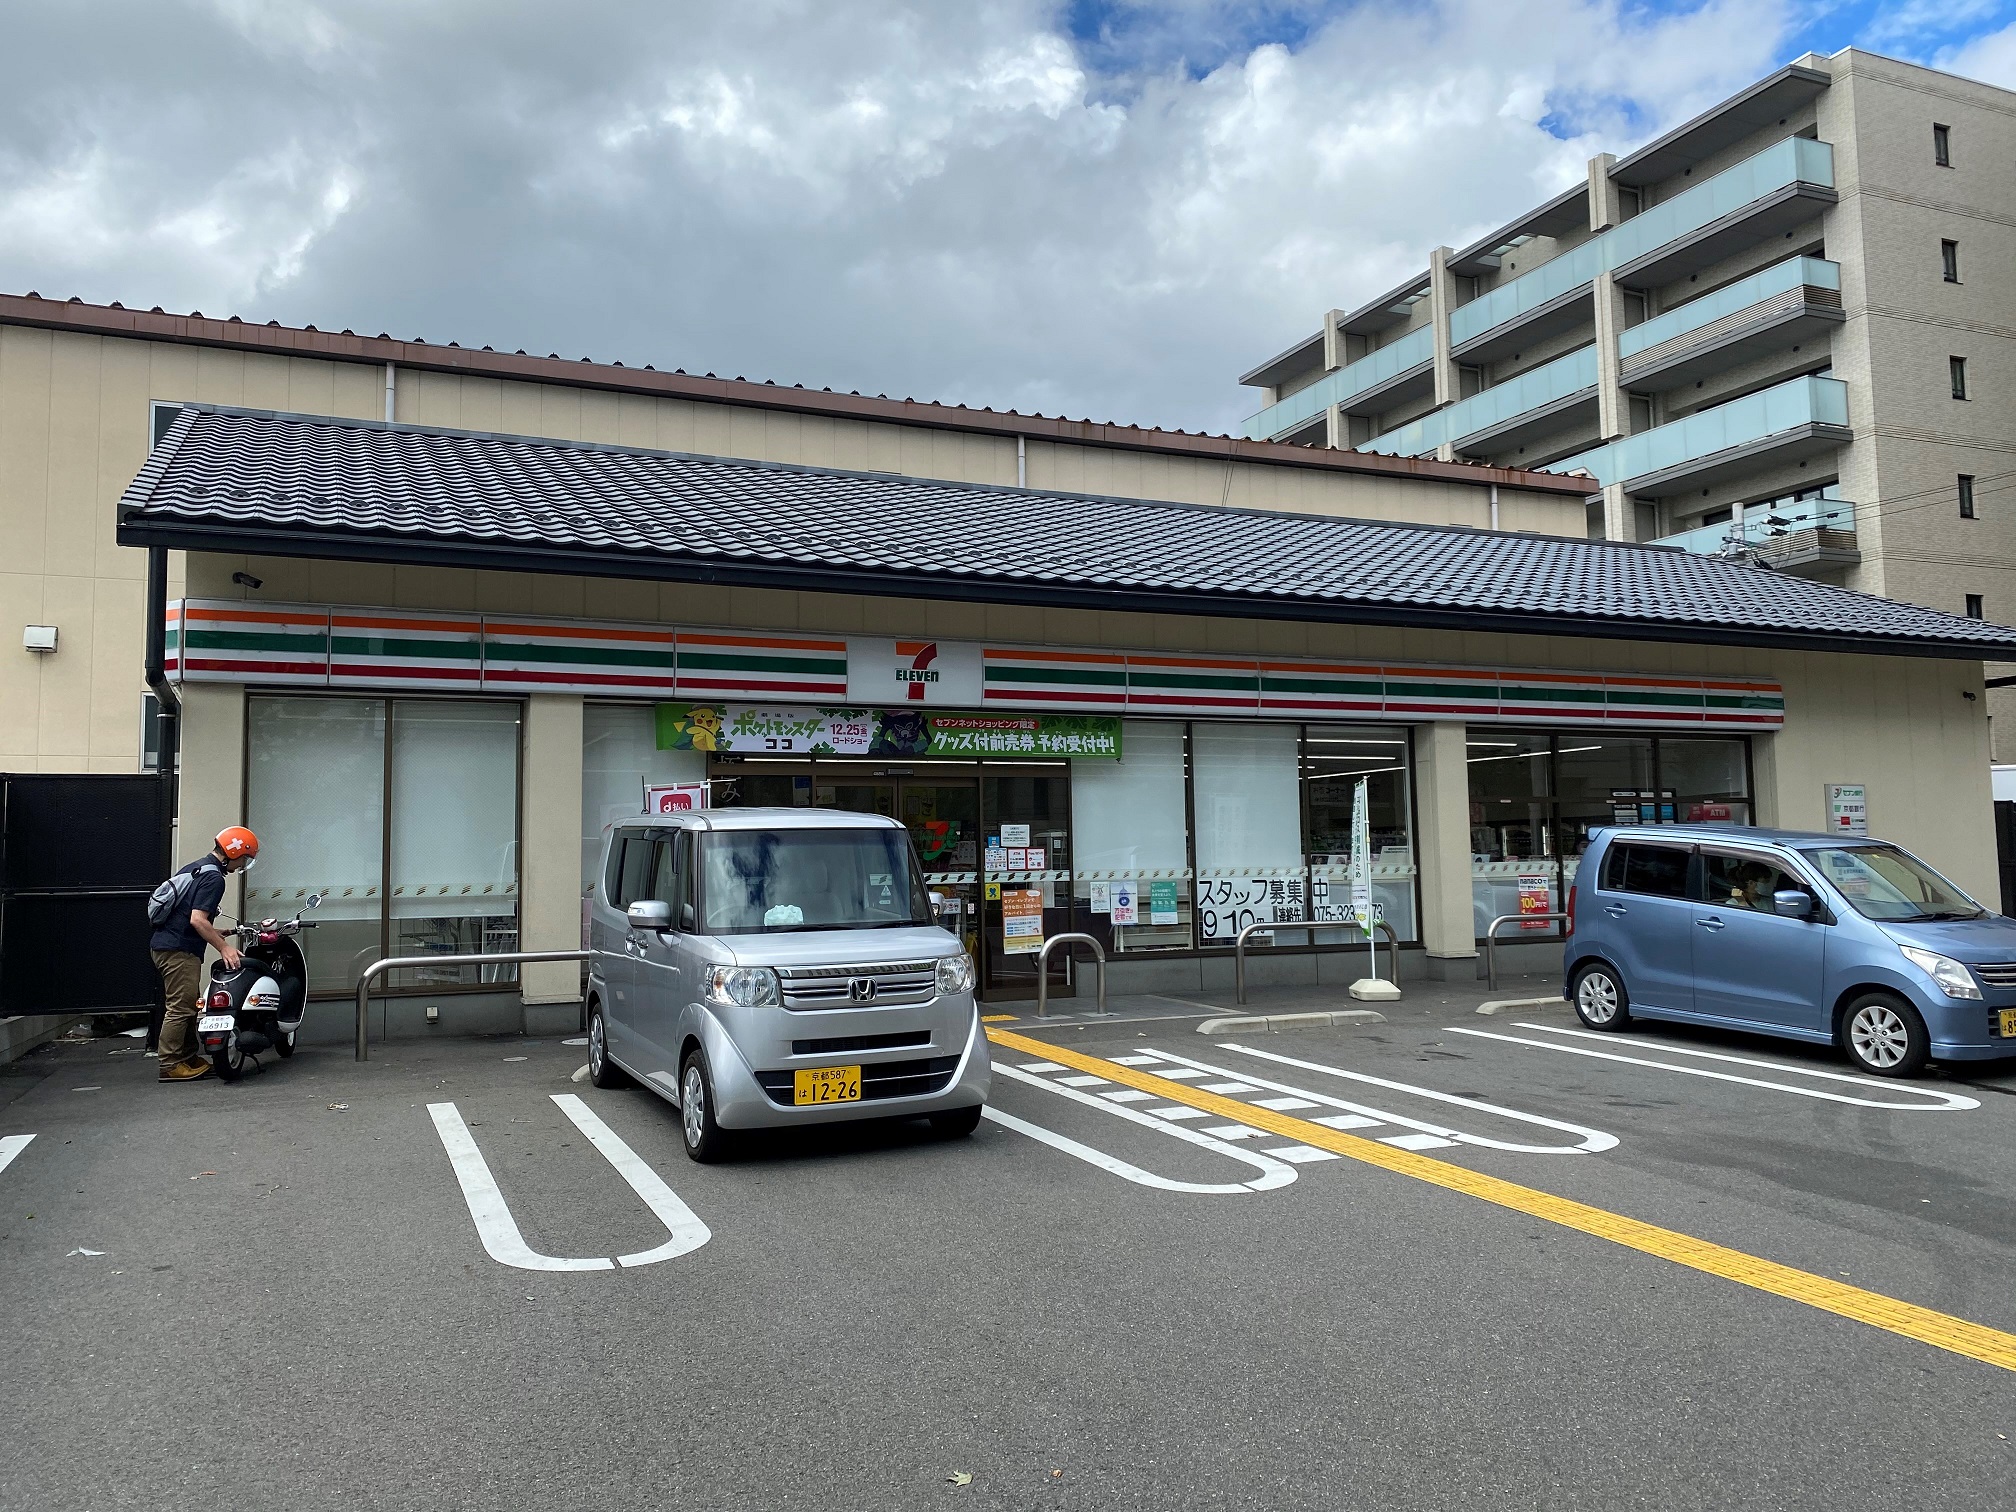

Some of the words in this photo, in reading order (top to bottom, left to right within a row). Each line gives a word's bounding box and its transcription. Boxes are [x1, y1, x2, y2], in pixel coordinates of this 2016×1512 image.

[730, 709, 826, 739] ポケットモンスター
[830, 723, 860, 736] 12.25
[935, 718, 1036, 730] セブンネットショッピング限定
[765, 738, 793, 750] ココ
[832, 736, 868, 745] ロードショー
[1198, 879, 1303, 906] スタッフ募集
[1313, 878, 1329, 905] 中
[798, 1088, 808, 1098] は
[812, 1080, 858, 1102] 12-26
